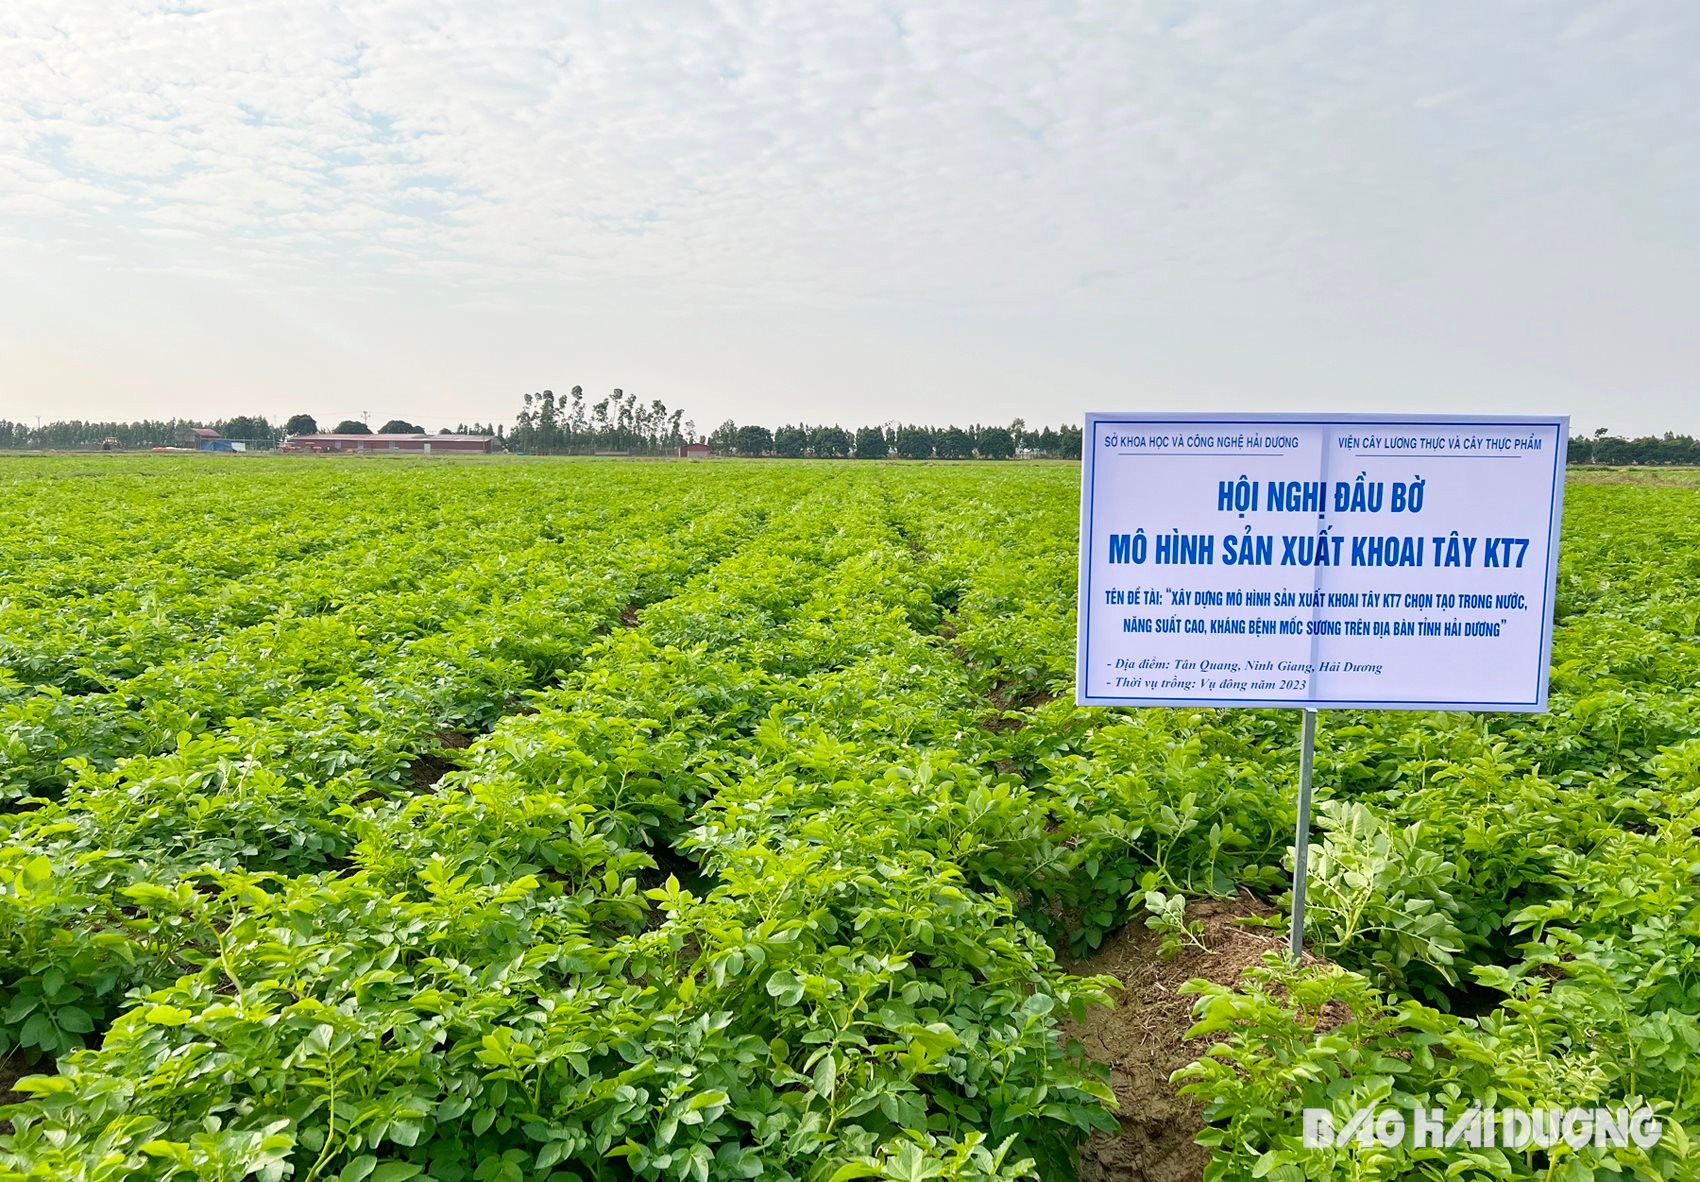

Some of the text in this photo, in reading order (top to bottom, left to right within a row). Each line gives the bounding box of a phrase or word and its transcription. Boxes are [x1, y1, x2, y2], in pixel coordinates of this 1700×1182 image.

[1105, 433, 1299, 450] SỞ KHOA HỌC VÀ CÔNG NGHỆ HẢI DƯƠNG
[1338, 432, 1542, 452] VIỆN CÂY LƯƠNG THỰC VÀ CÂY THỰC PHẨM
[1218, 471, 1426, 519] HỘI NGHỊ ĐẦU BỜ
[1109, 523, 1530, 568] MÔ HÌNH SẢN XUẤT KHOAI TÂY KT7
[1105, 588, 1124, 605] TÊN
[1127, 586, 1141, 606] ĐỀ
[1144, 588, 1163, 606] TÀI:
[1195, 590, 1223, 609] DỰNG
[1226, 589, 1243, 606] MÔ
[1246, 588, 1271, 607] HÌNH
[1274, 588, 1296, 607] SẢN
[1299, 588, 1326, 608] XUẤT
[1328, 593, 1359, 608] KHOAI
[1362, 591, 1380, 608] TÂY
[1383, 594, 1402, 608] KT7
[1404, 594, 1433, 612] CHỌN
[1436, 594, 1455, 611] TẠO
[1459, 594, 1492, 609] TRONG
[1496, 592, 1528, 611] NƯỚC,
[1123, 616, 1152, 633] NĂNG
[1155, 614, 1182, 633] SUẤT
[1185, 619, 1207, 635] CAO,
[1211, 616, 1246, 634] KHÁNG
[1249, 617, 1276, 637] BỆNH
[1280, 616, 1303, 635] MỐC
[1306, 618, 1342, 636] SƯƠNG
[1345, 618, 1370, 636] TRÊN
[1373, 621, 1390, 639] ĐỊA
[1394, 619, 1415, 636] BÀN
[1418, 617, 1440, 636] TỈNH
[1444, 618, 1461, 637] HẢI
[1115, 658, 1136, 671] Địa
[1174, 659, 1196, 670] Tân
[1200, 660, 1241, 672] Quang,
[1245, 660, 1274, 671] Ninh
[1278, 661, 1315, 673] Giang,
[1319, 661, 1340, 672] Hải
[1344, 662, 1383, 674] Dương
[1115, 677, 1142, 688] Thời
[1145, 680, 1158, 690] vụ
[1161, 675, 1196, 690] trồng:
[1200, 679, 1215, 692] Vụ
[1217, 679, 1248, 692] đông
[1251, 680, 1276, 690] năm
[1279, 680, 1307, 690] 2023
